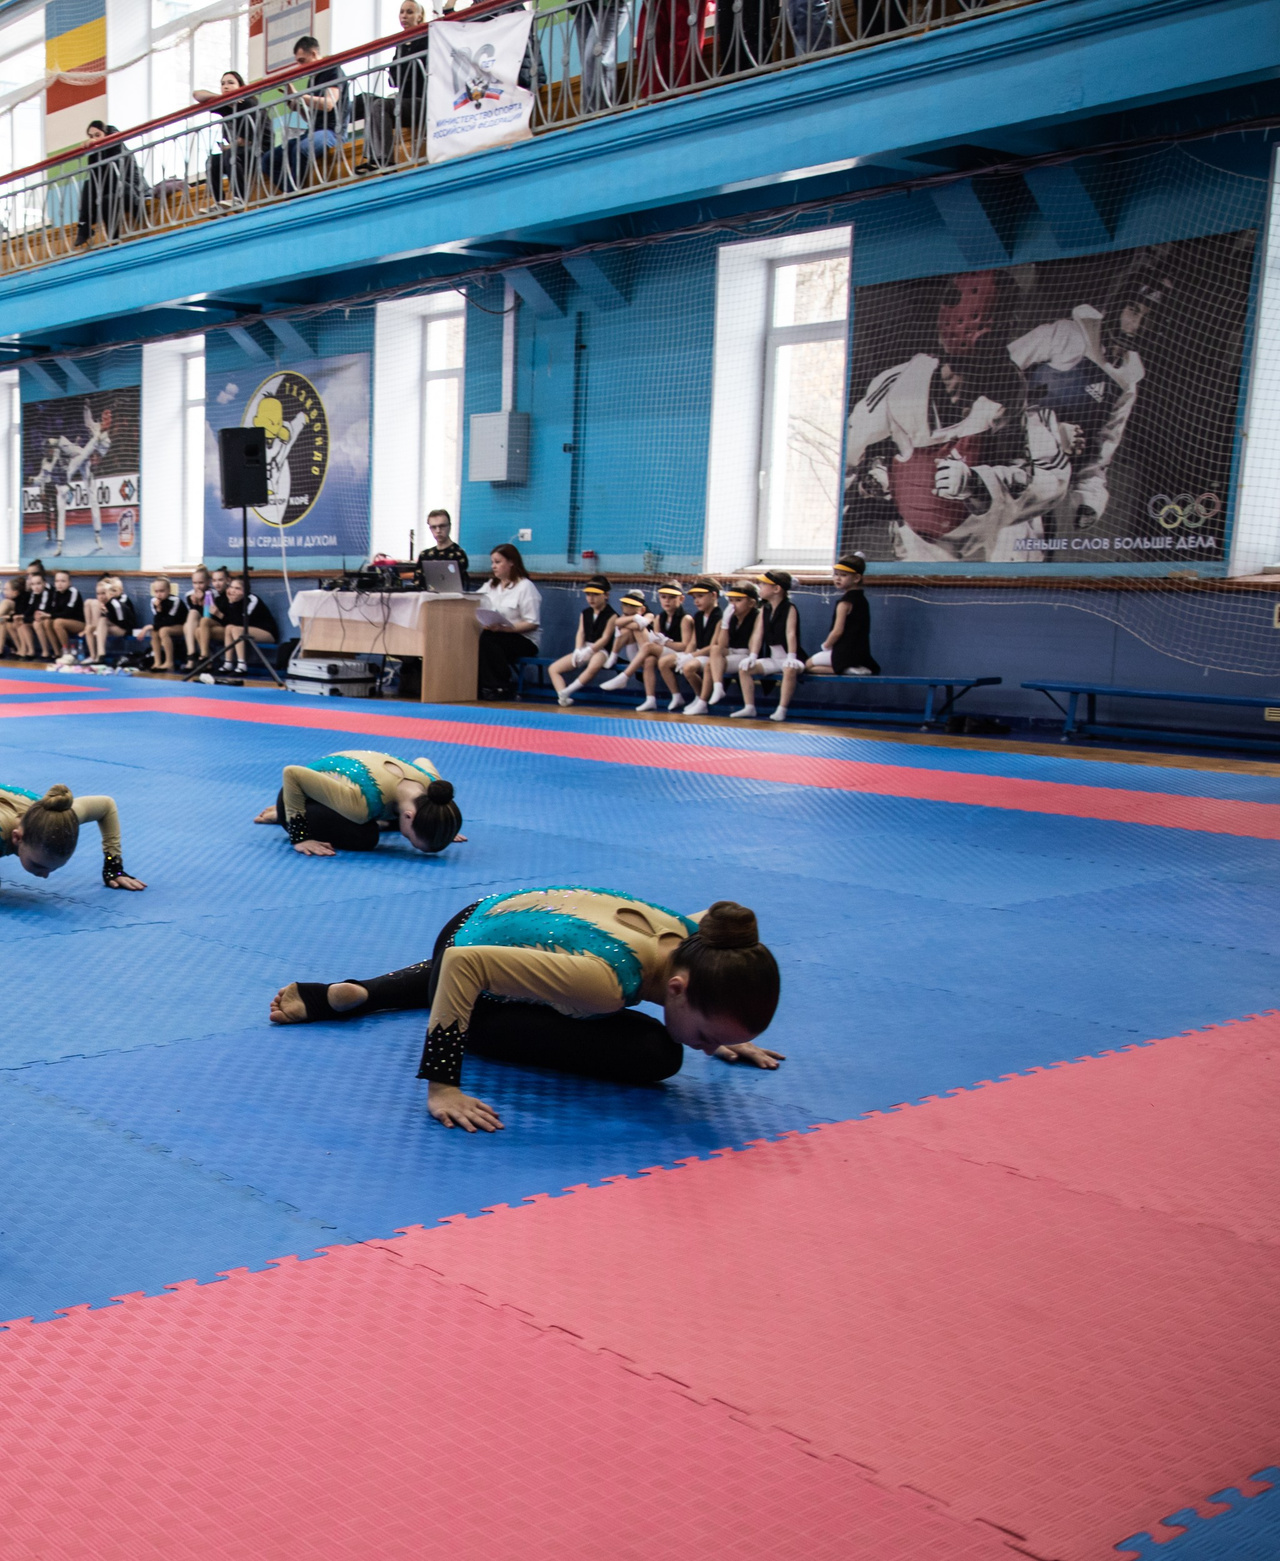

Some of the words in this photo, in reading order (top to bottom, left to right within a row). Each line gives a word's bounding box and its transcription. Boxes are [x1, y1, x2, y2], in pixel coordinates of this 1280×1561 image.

[494, 102, 522, 117] СПОРТА
[296, 536, 303, 547] И
[304, 535, 338, 548] ДУХОМ
[1015, 538, 1068, 550] МЕНЬШЕ
[1070, 538, 1110, 550] СЛОВ
[1113, 536, 1172, 550] БОЛЬШЕ
[1176, 536, 1217, 550] ДЕЛА
